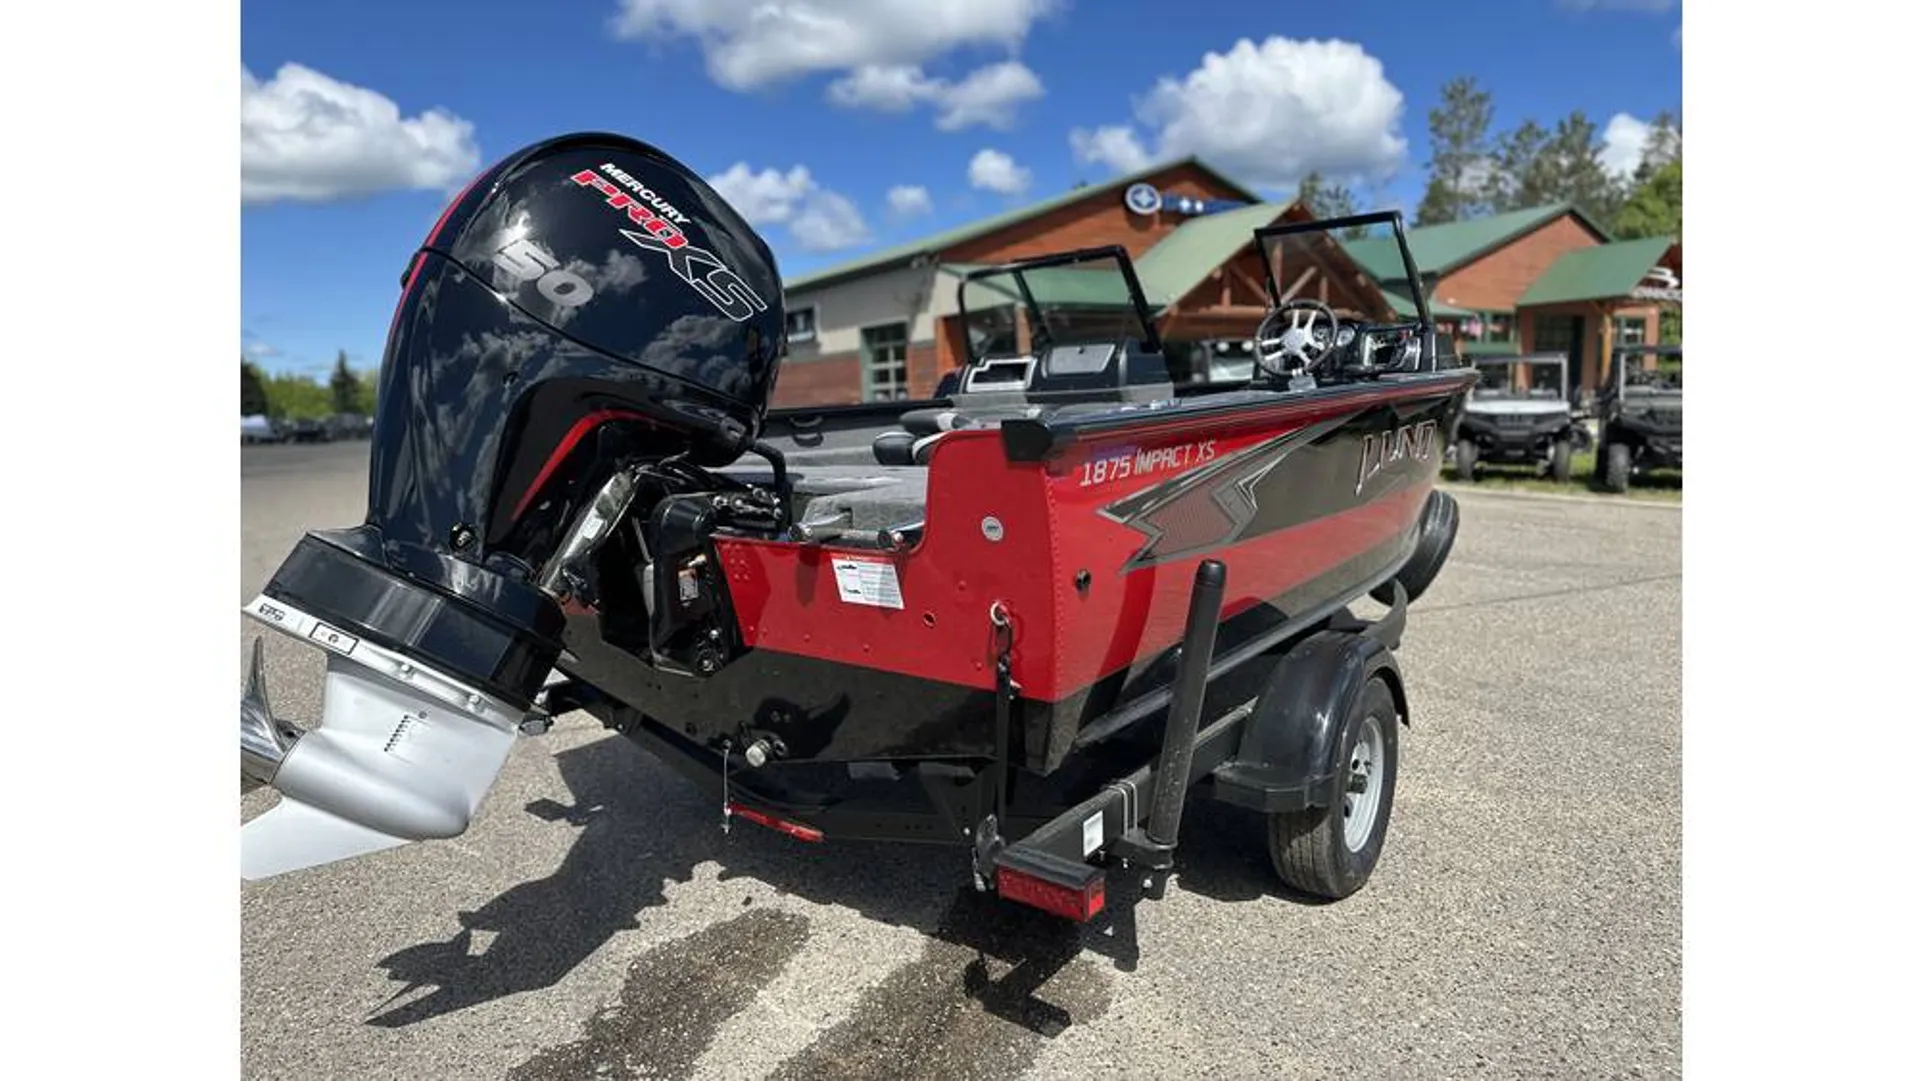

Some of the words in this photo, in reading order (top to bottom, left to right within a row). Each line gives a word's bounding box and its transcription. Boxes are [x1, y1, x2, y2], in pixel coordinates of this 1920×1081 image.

[570, 169, 689, 249] PRO
[600, 162, 691, 224] MERCURY
[619, 228, 767, 321] XS
[1079, 455, 1132, 487] 1875
[1133, 444, 1194, 475] IMPACT
[1196, 439, 1217, 463] XS
